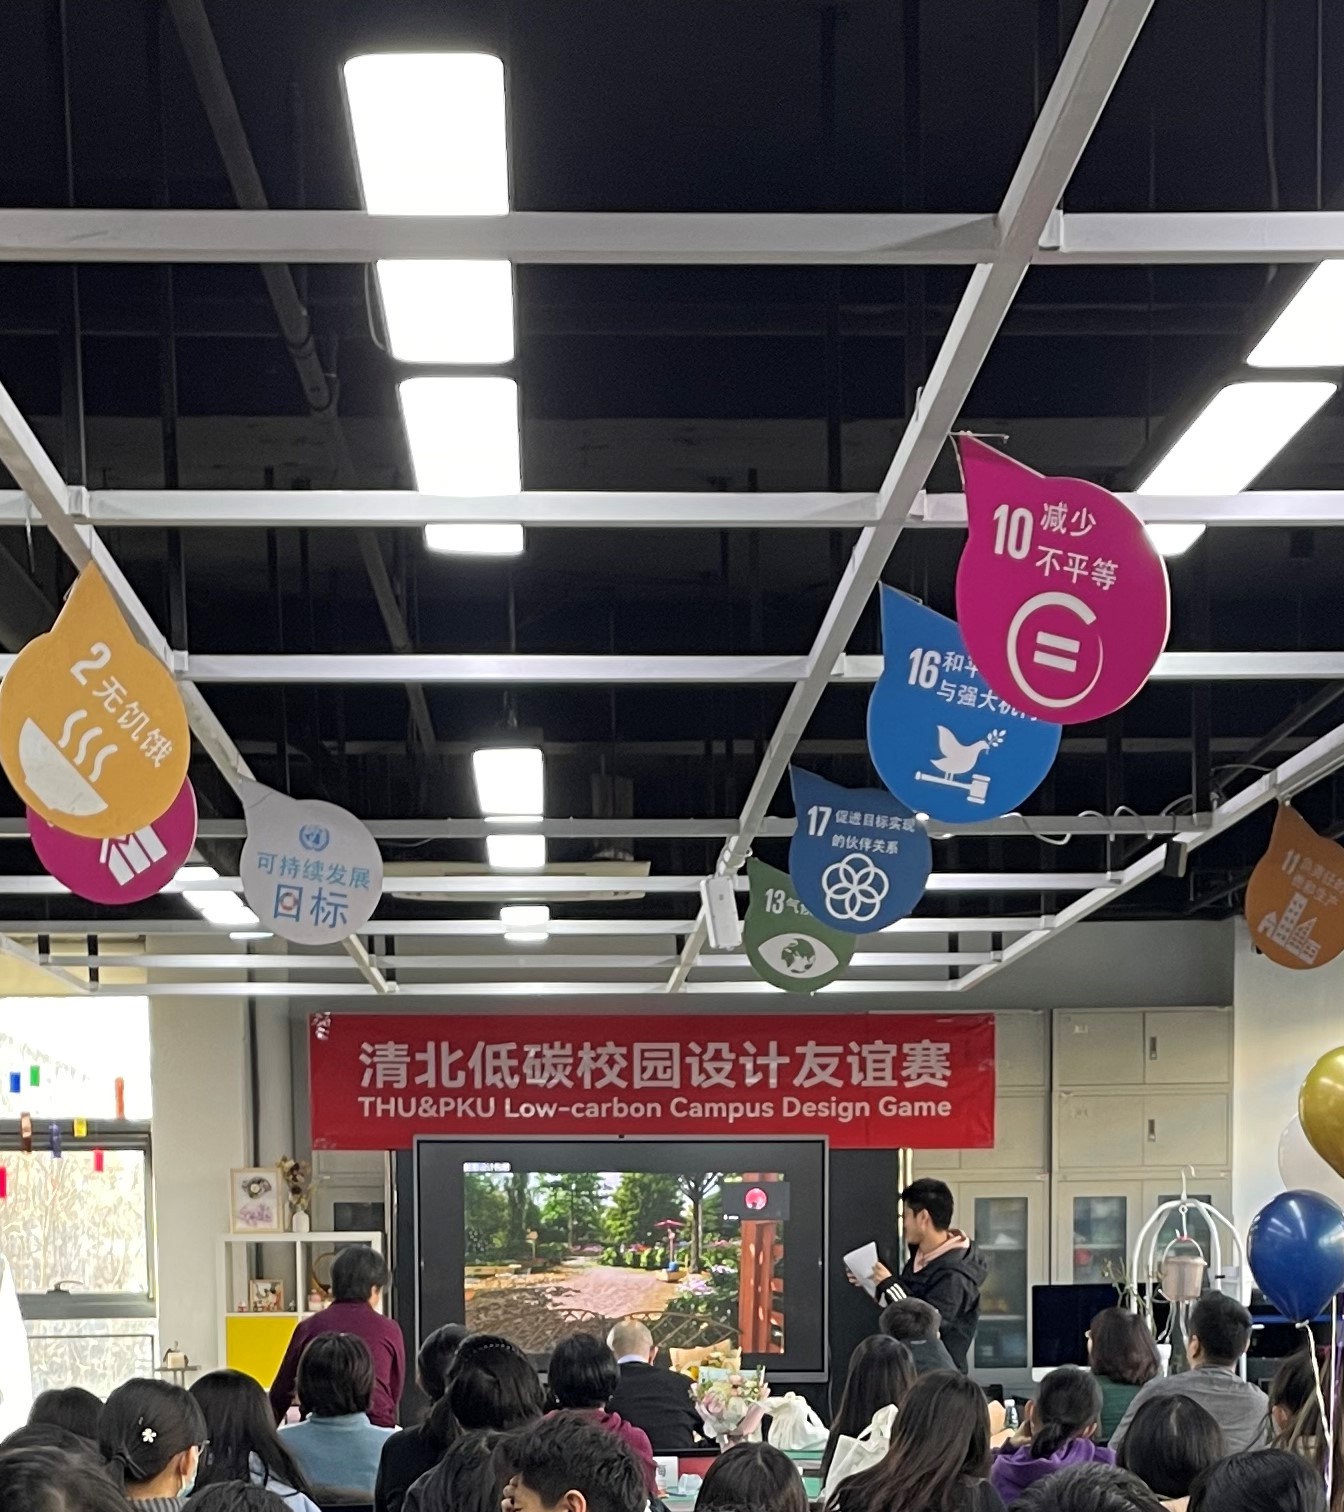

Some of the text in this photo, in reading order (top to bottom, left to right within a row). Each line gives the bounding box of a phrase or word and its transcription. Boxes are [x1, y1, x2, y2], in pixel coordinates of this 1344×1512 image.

[993, 504, 1034, 559] 10
[1040, 501, 1097, 537] 减少
[1035, 545, 1119, 591] 不平等
[908, 648, 941, 688] 16
[70, 642, 174, 768] 2 无饥饿
[807, 805, 832, 836] 17
[835, 809, 916, 832] 促进目标实现
[832, 834, 899, 854] 的伙伴关系
[257, 852, 371, 891] 可持续发展
[765, 888, 786, 914] 13
[358, 1039, 952, 1089] 清北低碳校园设计友谊赛
[357, 1096, 952, 1123] THU&PKU Low-carbon Campus Design Game
